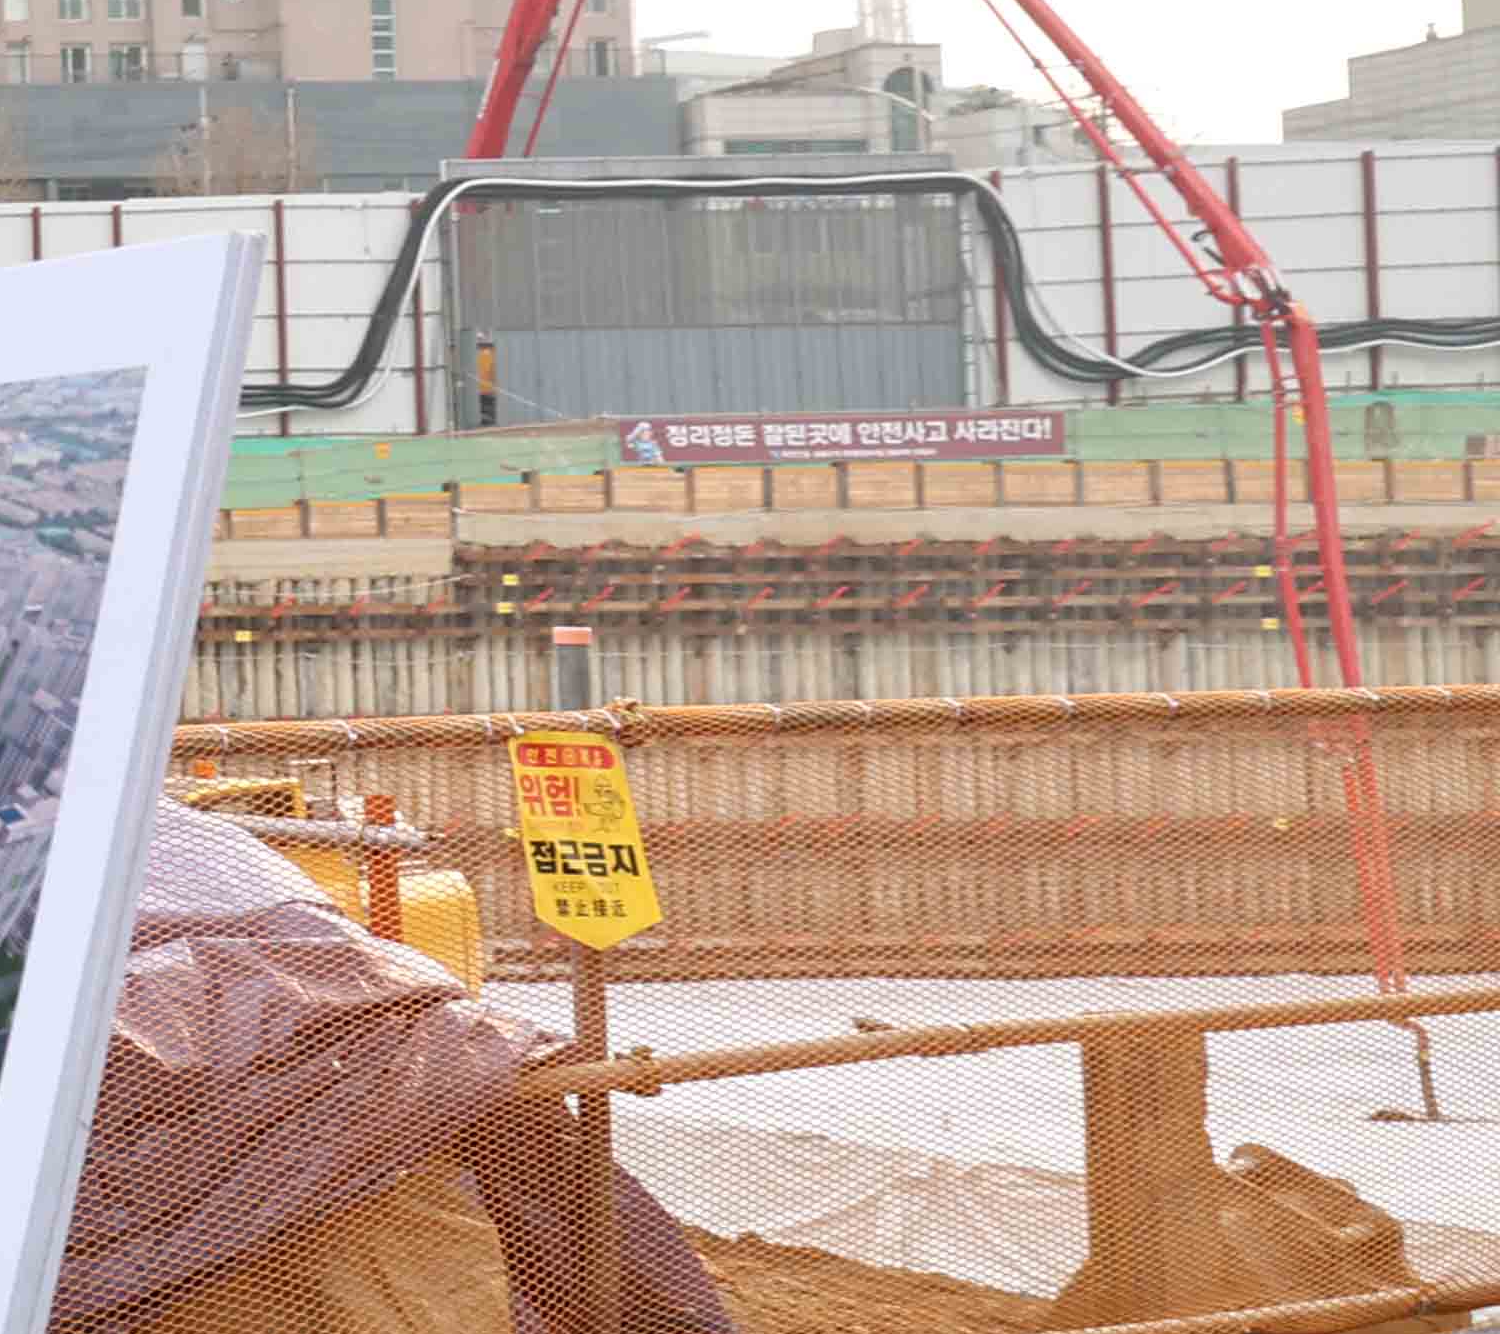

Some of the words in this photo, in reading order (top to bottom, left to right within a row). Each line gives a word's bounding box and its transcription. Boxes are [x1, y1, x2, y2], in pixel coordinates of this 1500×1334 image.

[665, 423, 756, 447] 정리정돈
[857, 420, 949, 445] 안전사고
[954, 416, 1053, 443] 사라진다!
[529, 839, 640, 877] 접근금지
